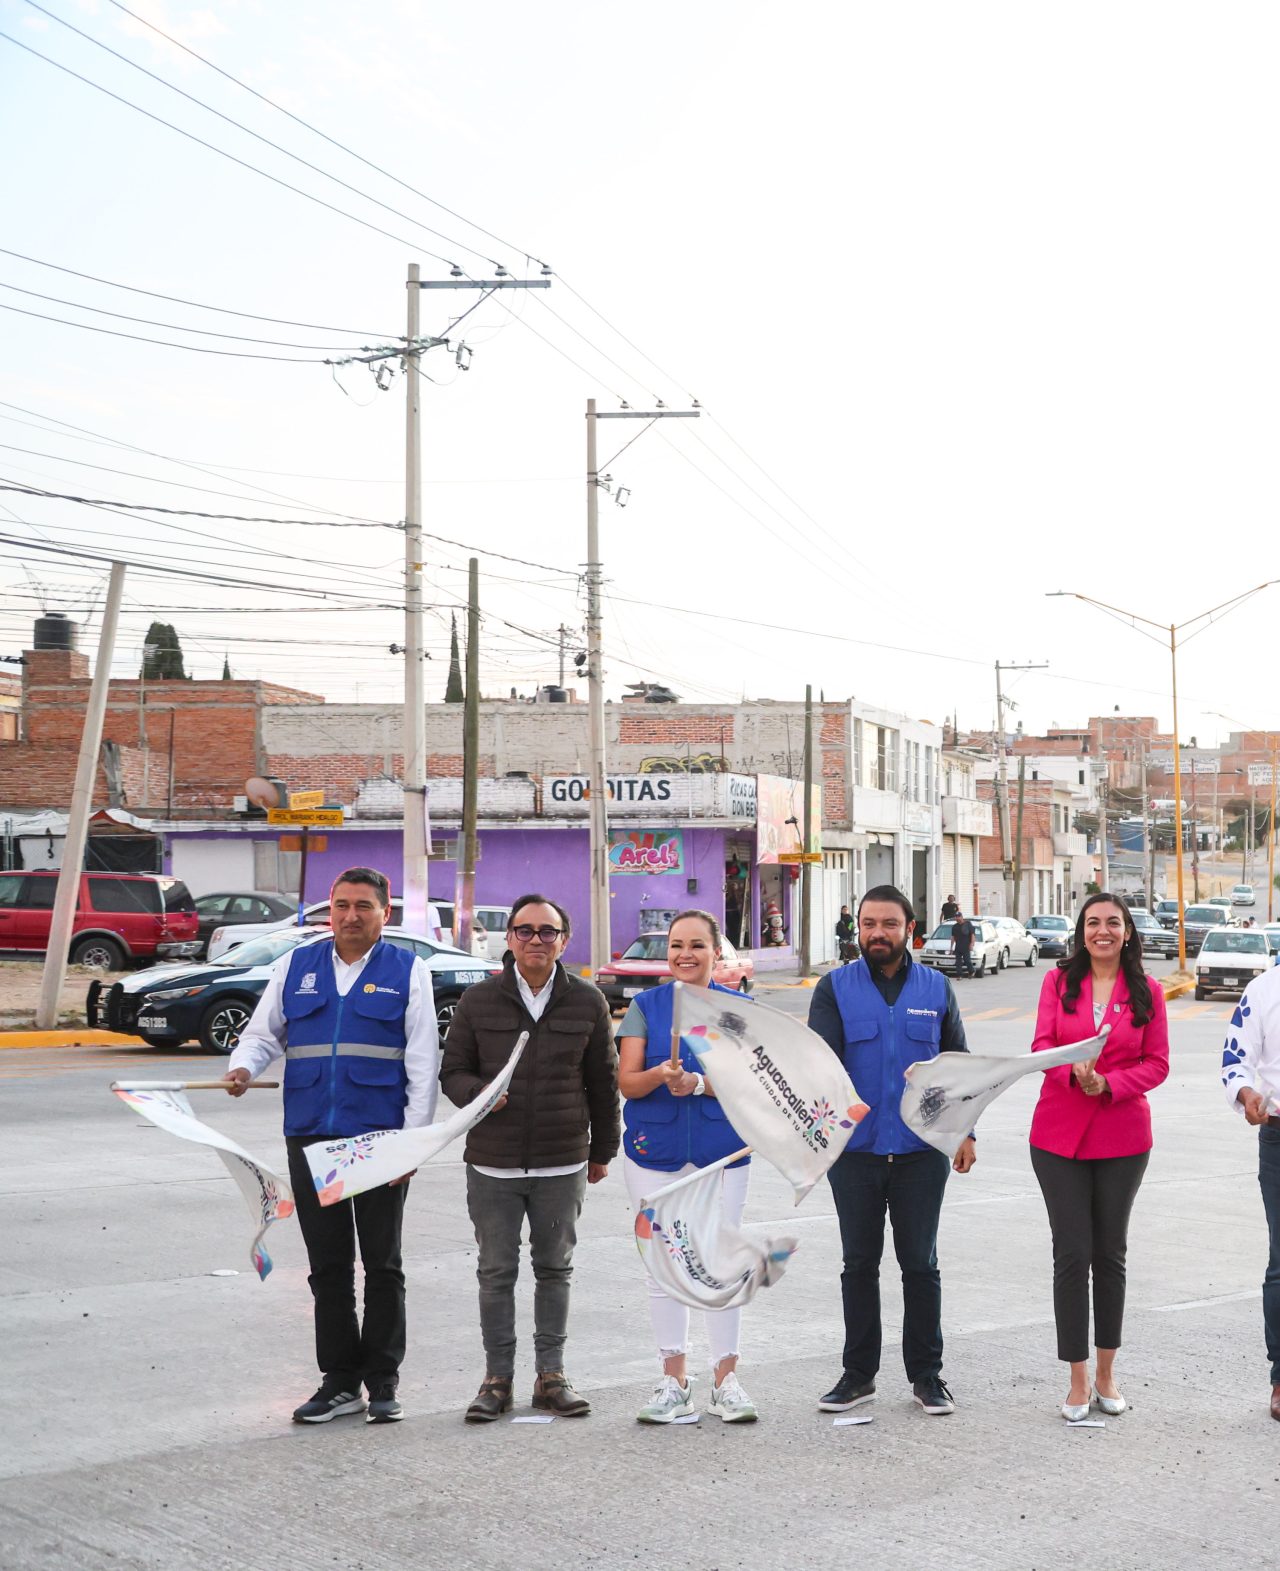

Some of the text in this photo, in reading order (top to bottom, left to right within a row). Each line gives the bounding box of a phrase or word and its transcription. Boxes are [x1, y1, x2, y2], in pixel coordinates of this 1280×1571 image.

[732, 800, 745, 815] DON
[749, 1063, 819, 1154] LA CIUDAD DE TU VIDA
[752, 1044, 830, 1150] Aguascalientes
